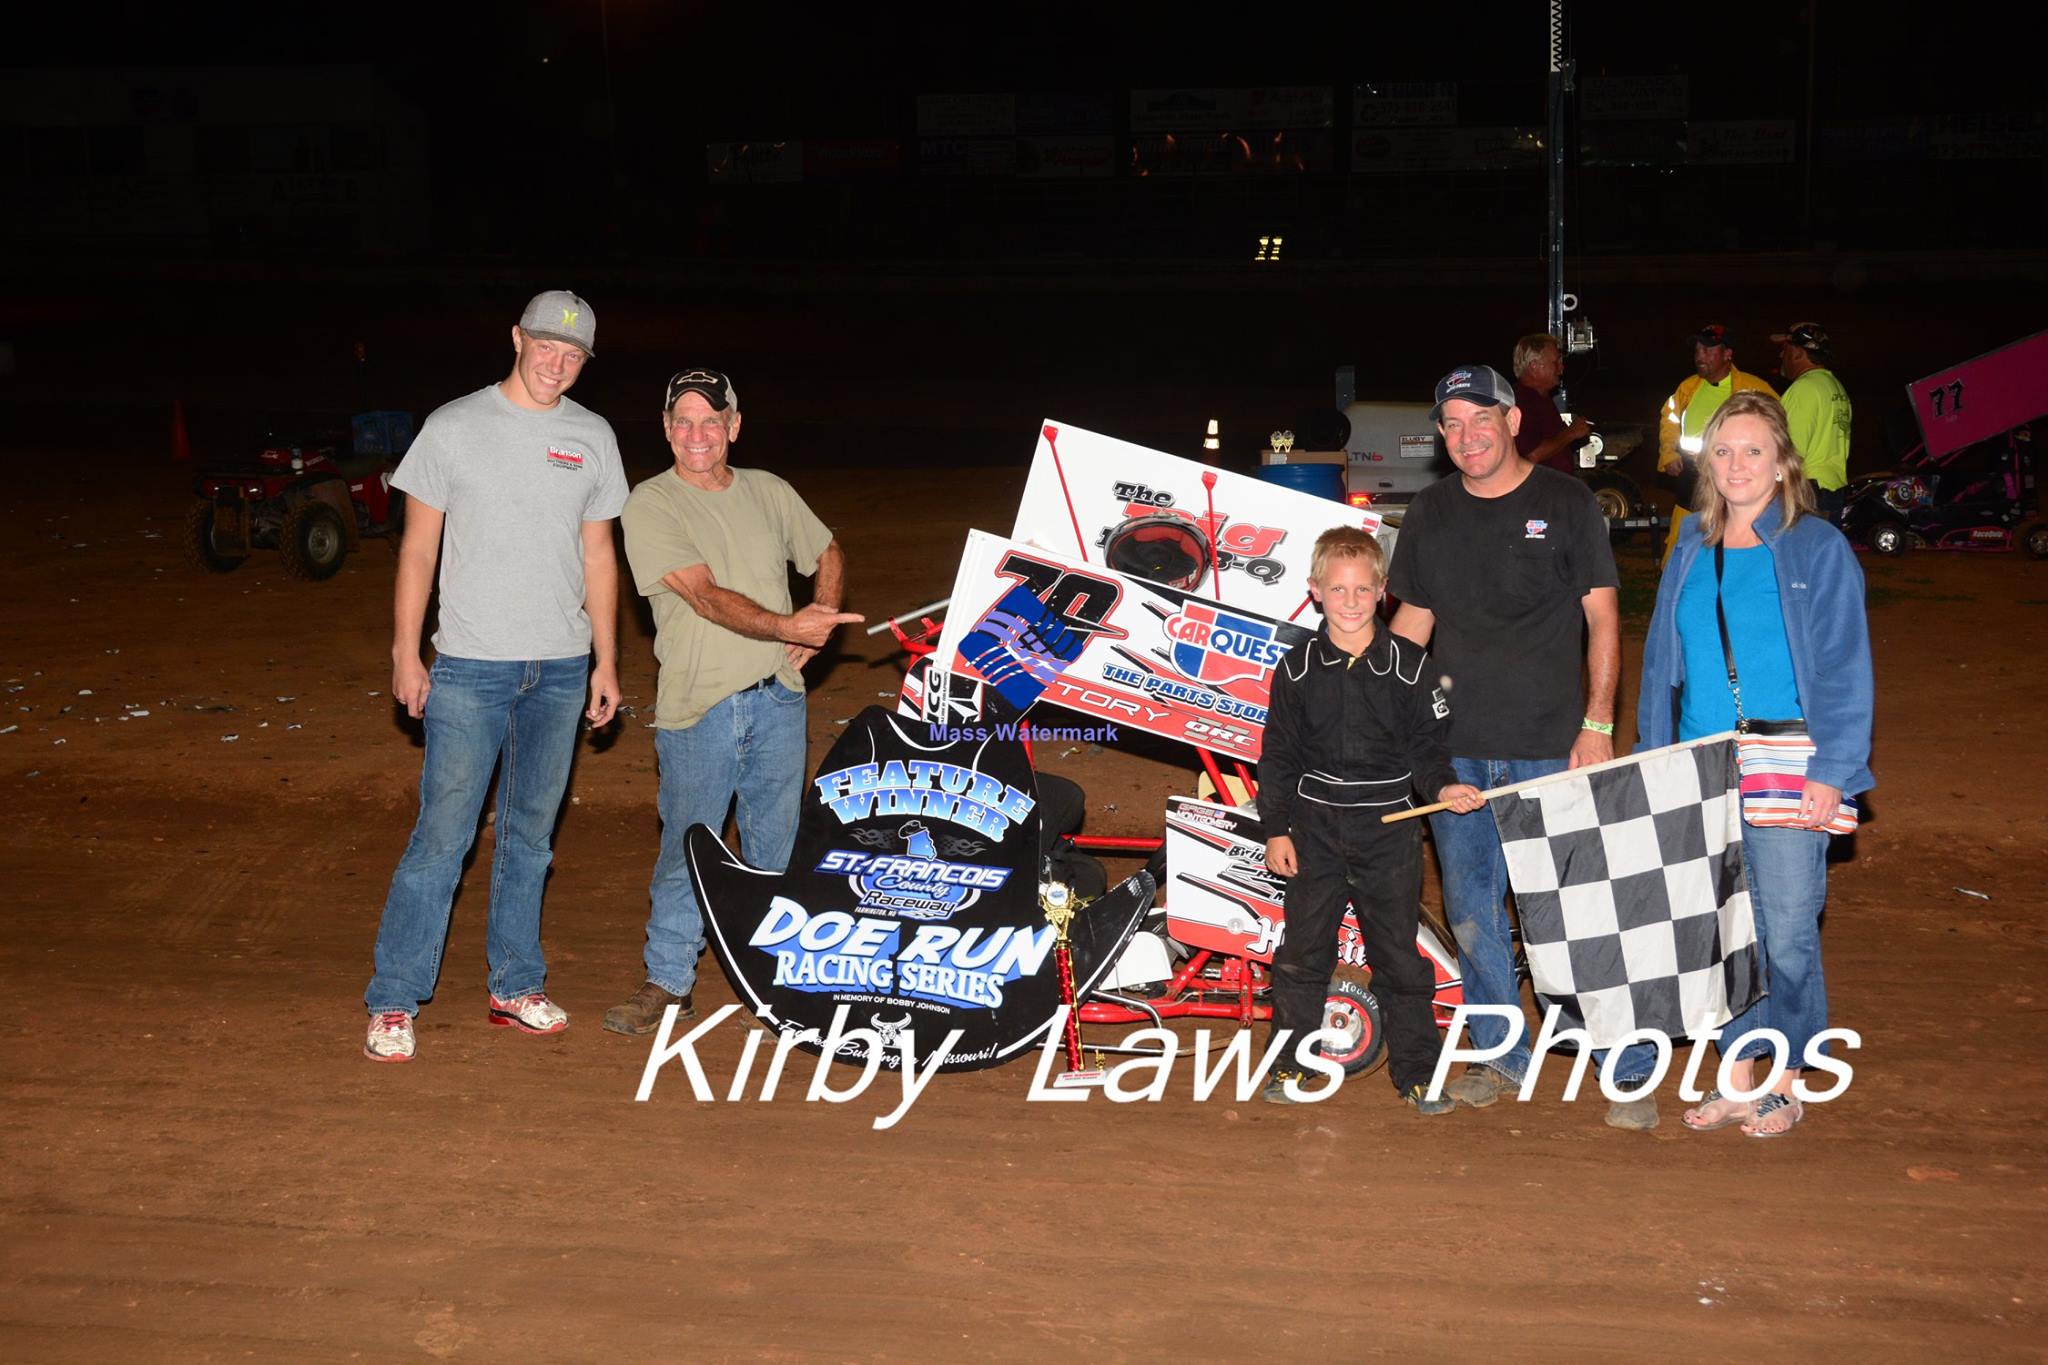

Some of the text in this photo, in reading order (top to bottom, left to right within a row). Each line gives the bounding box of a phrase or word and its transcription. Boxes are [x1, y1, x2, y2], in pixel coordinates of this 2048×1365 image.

[1929, 378, 1964, 417] 77
[1348, 451, 1384, 461] TN6
[1112, 480, 1175, 508] The
[1167, 615, 1293, 667] CARQUES
[1104, 663, 1269, 726] THE PARTS STOR
[814, 760, 1036, 825] FEATURE
[829, 788, 1010, 843] WINNER
[864, 857, 1006, 888] FRANCOIS
[875, 874, 950, 899] County
[863, 890, 956, 917] Raceway
[749, 895, 1058, 977] DOE RUN
[772, 950, 1004, 1009] RACING SERIES
[840, 994, 873, 1003] MEMORY
[874, 996, 886, 1004] OF
[886, 997, 916, 1008] BOBBY
[916, 1002, 950, 1014] JOHNSON
